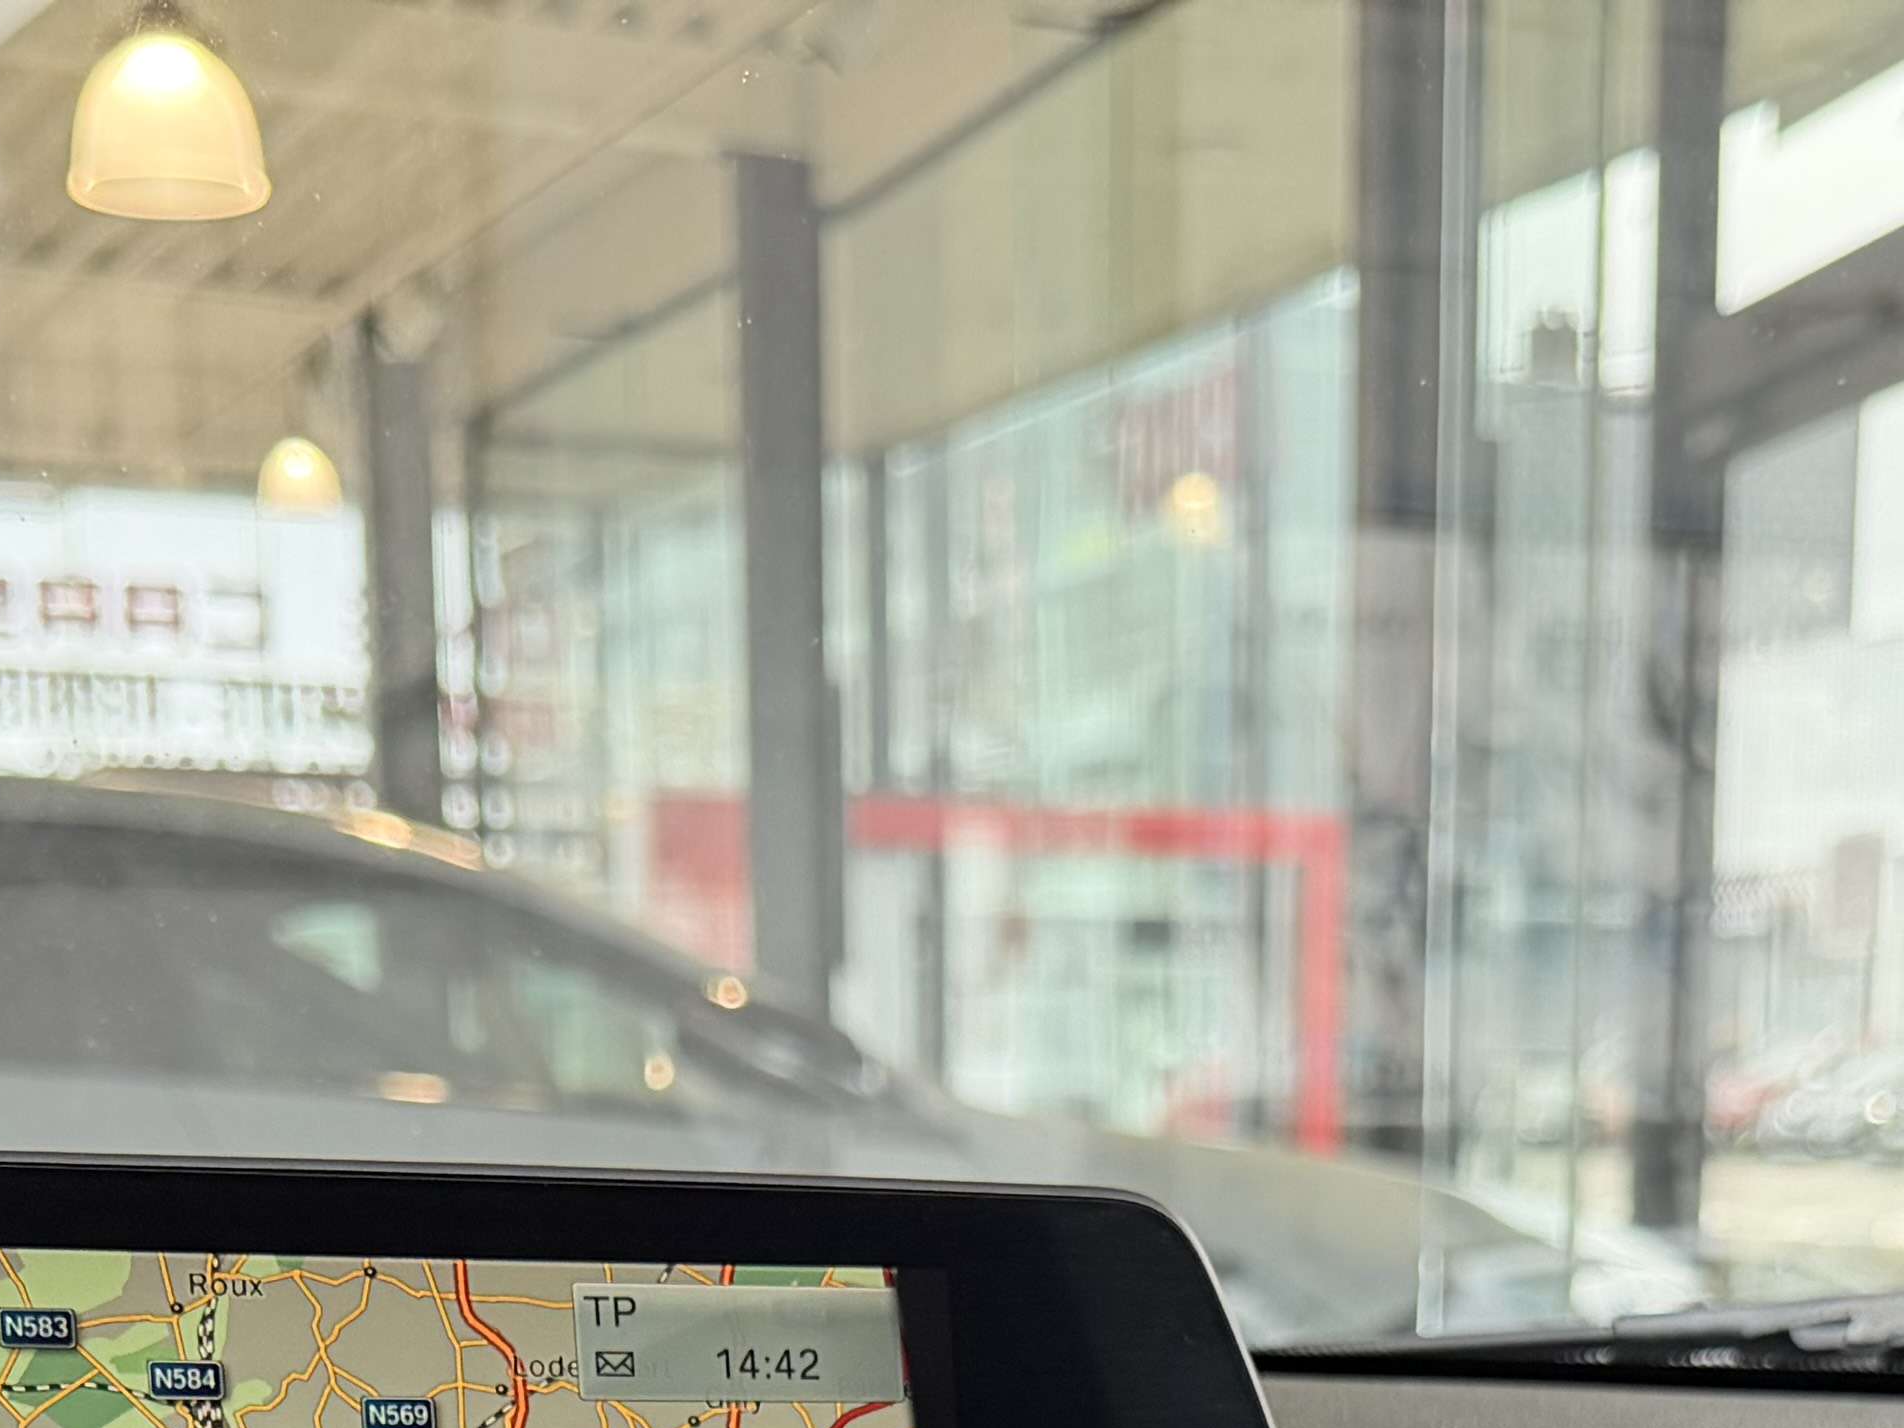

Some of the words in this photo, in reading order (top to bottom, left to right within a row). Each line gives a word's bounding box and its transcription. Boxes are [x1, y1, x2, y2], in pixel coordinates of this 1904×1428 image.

[189, 1273, 263, 1297] Roux
[583, 1295, 637, 1327] TP
[5, 1316, 69, 1338] N583
[716, 1348, 821, 1380] 14:42
[154, 1368, 217, 1390] N584
[368, 1405, 429, 1426] N569
